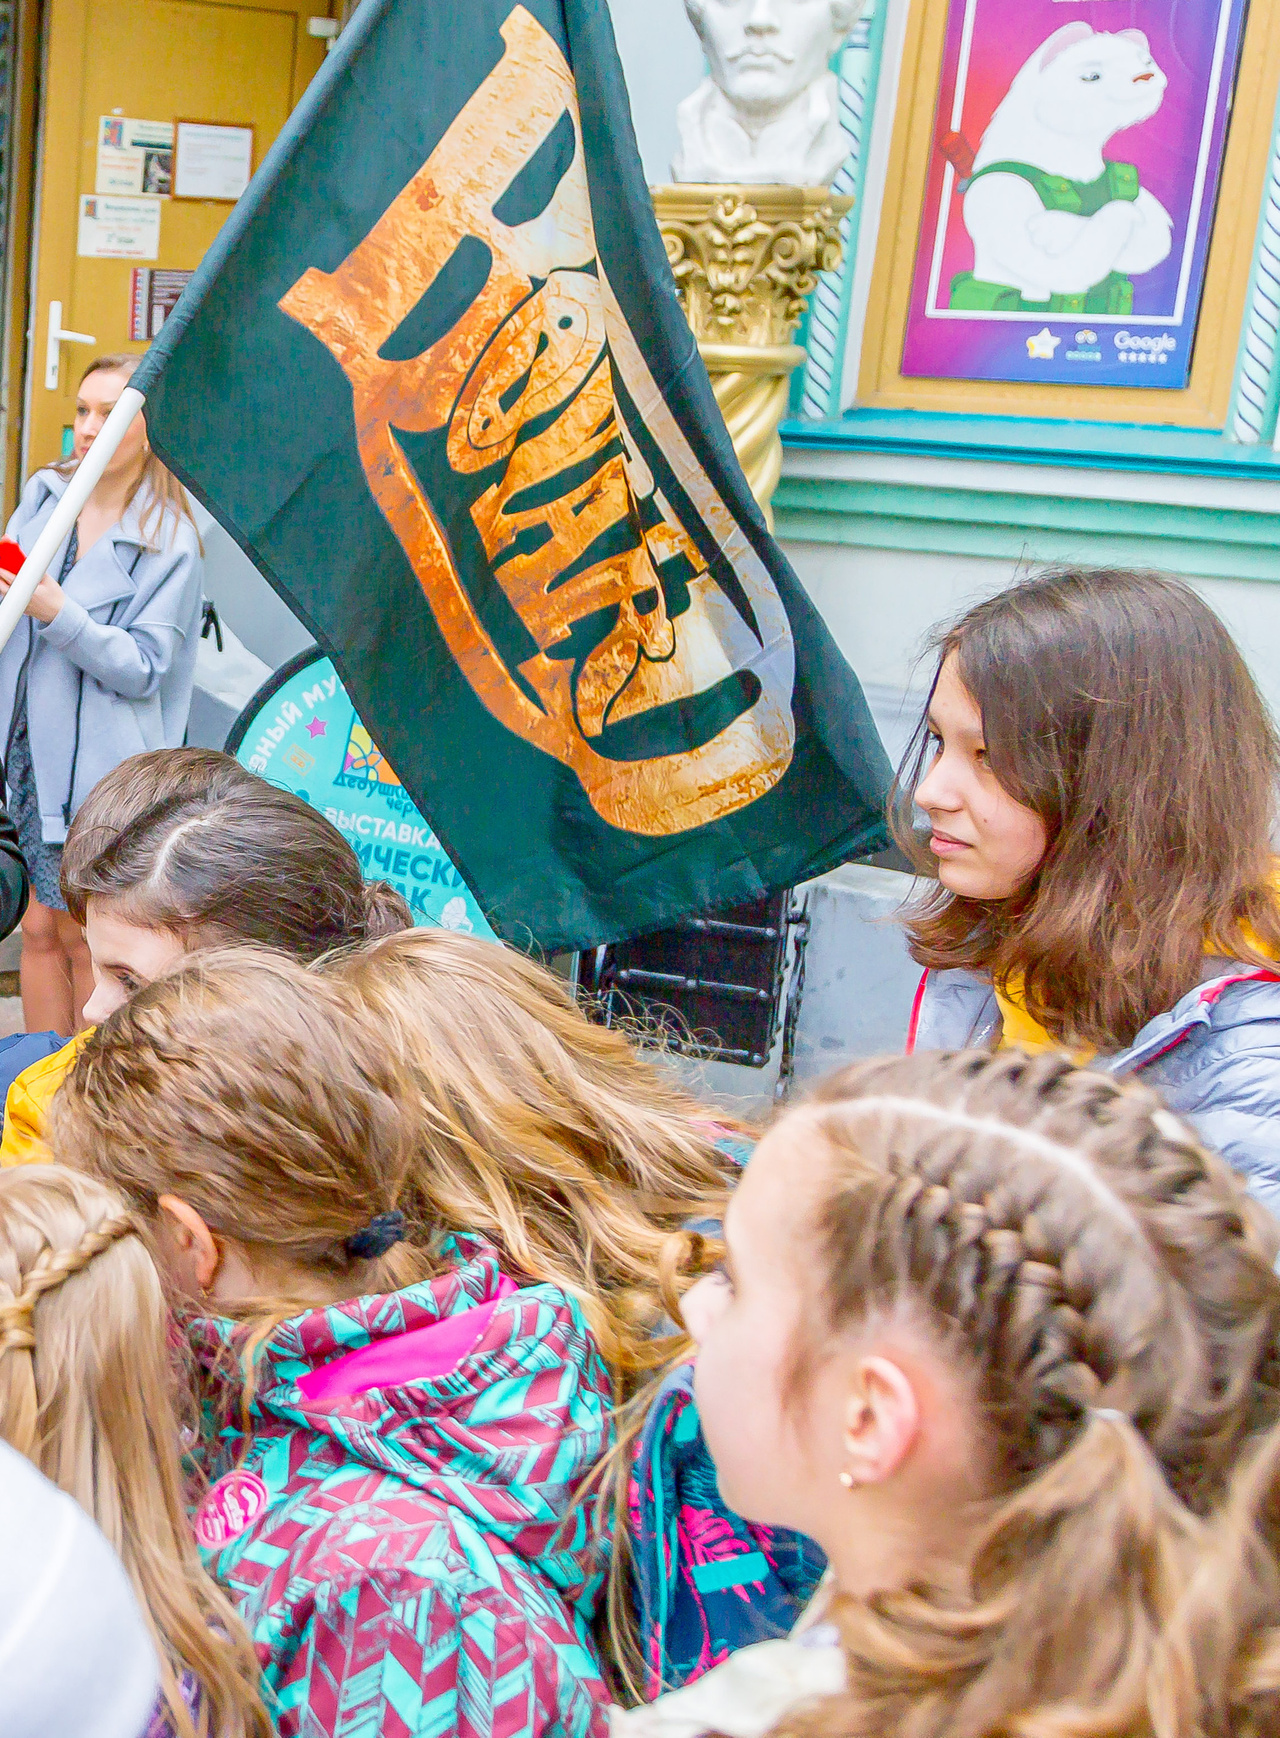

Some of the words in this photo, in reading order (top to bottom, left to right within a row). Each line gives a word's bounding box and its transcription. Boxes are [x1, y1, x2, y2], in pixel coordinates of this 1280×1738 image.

[1114, 330, 1177, 353] Google
[278, 4, 795, 836] BOYARD
[302, 675, 347, 710] МУ
[385, 796, 421, 819] чер
[325, 806, 441, 851] ВЫСТАВКА
